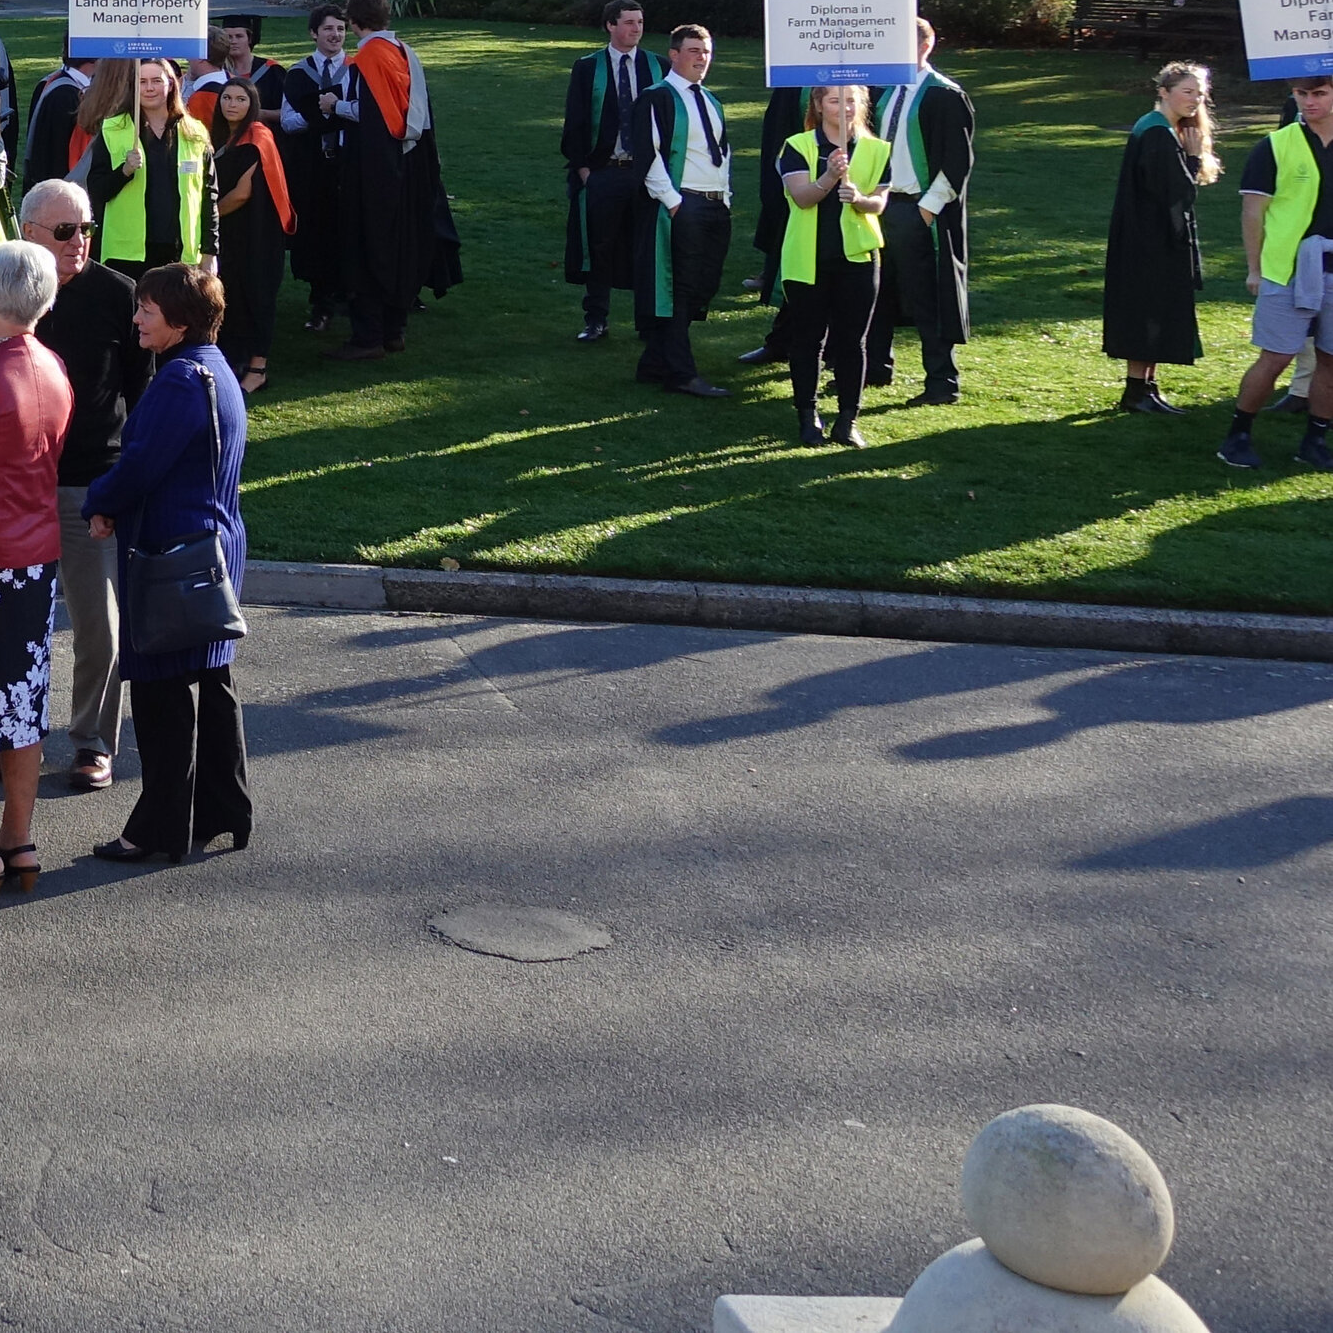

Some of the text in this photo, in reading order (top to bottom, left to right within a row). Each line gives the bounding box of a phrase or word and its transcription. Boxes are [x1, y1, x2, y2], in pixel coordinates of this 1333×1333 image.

[810, 4, 872, 16] Diploma in
[92, 12, 184, 26] Management
[787, 16, 896, 29] Farm Management
[798, 28, 885, 40] and Diploma in
[1273, 28, 1333, 42] Manag
[809, 41, 875, 52] Agriculture
